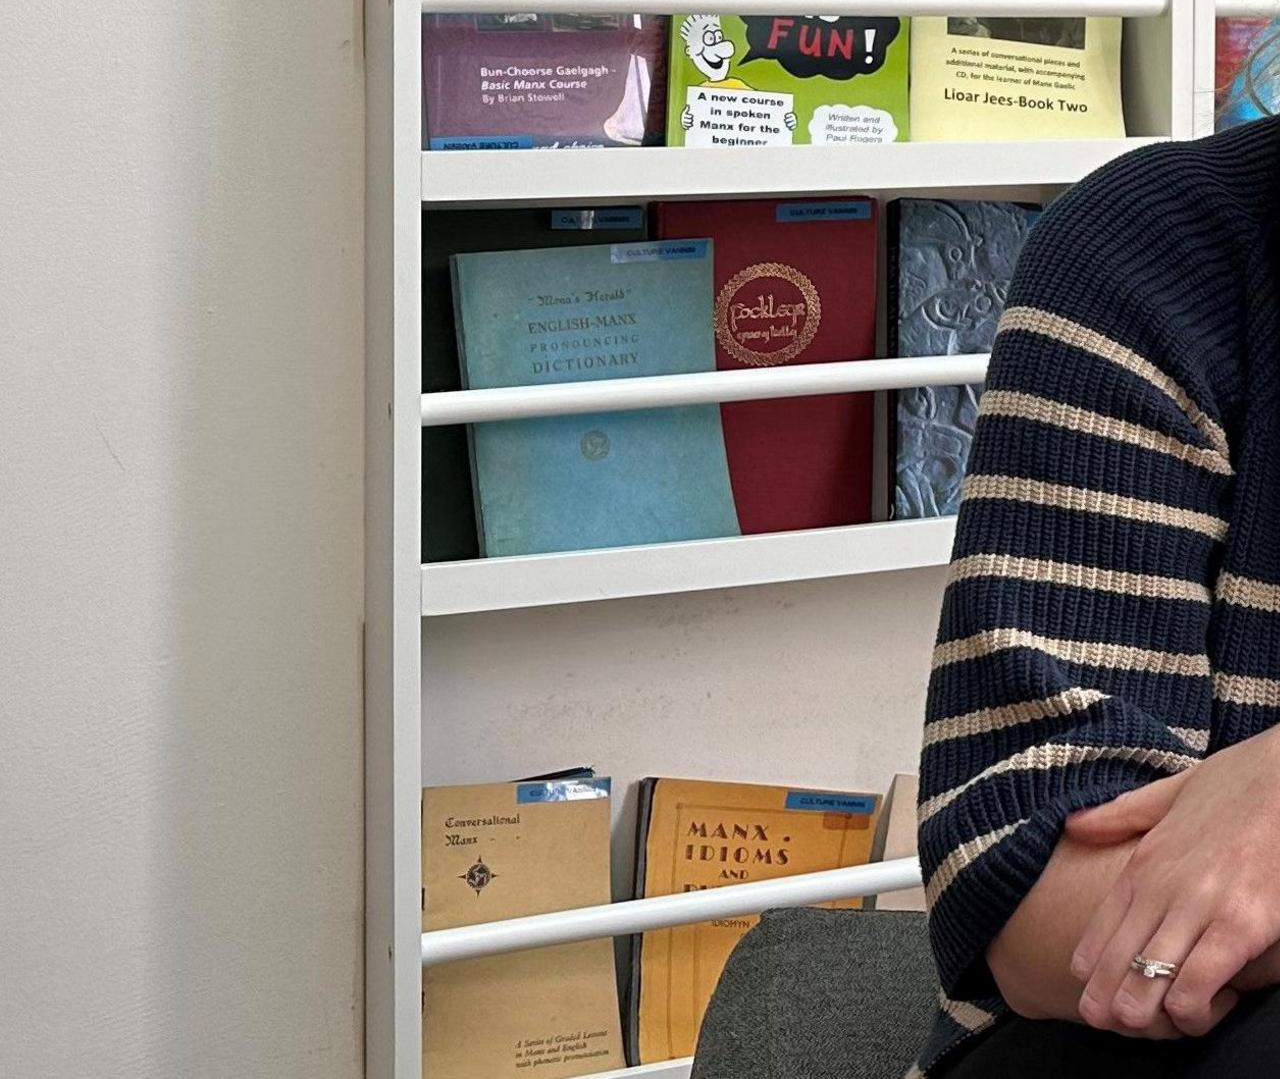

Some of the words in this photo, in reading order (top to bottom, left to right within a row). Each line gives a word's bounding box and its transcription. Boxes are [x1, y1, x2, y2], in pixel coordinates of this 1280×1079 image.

[480, 67, 553, 77] Bun-Choorse
[556, 67, 609, 78] Gaelgagh
[481, 79, 511, 90] Basic
[514, 79, 545, 90] Manx
[549, 79, 587, 89] Course
[482, 94, 495, 105] By
[497, 93, 525, 103] Brian
[527, 93, 565, 103] Stowell
[698, 92, 707, 100] A
[711, 94, 737, 103] new
[742, 97, 784, 107] course
[944, 88, 980, 103] Lioar
[983, 92, 1054, 110] Jees-Book
[1057, 100, 1087, 113] Two
[710, 107, 721, 116] in
[726, 108, 771, 120] spoken
[700, 121, 734, 131] Manx
[738, 123, 755, 132] for
[760, 125, 780, 133] the
[528, 313, 638, 334] ENGLISH-MANX
[530, 333, 640, 353] PRONOUNCING
[532, 352, 639, 374] DICTIONARY
[445, 812, 520, 828] Conversational
[687, 821, 769, 842] MANX
[445, 834, 478, 846] Manx
[685, 844, 790, 865] IDIOMS
[719, 870, 749, 880] AND
